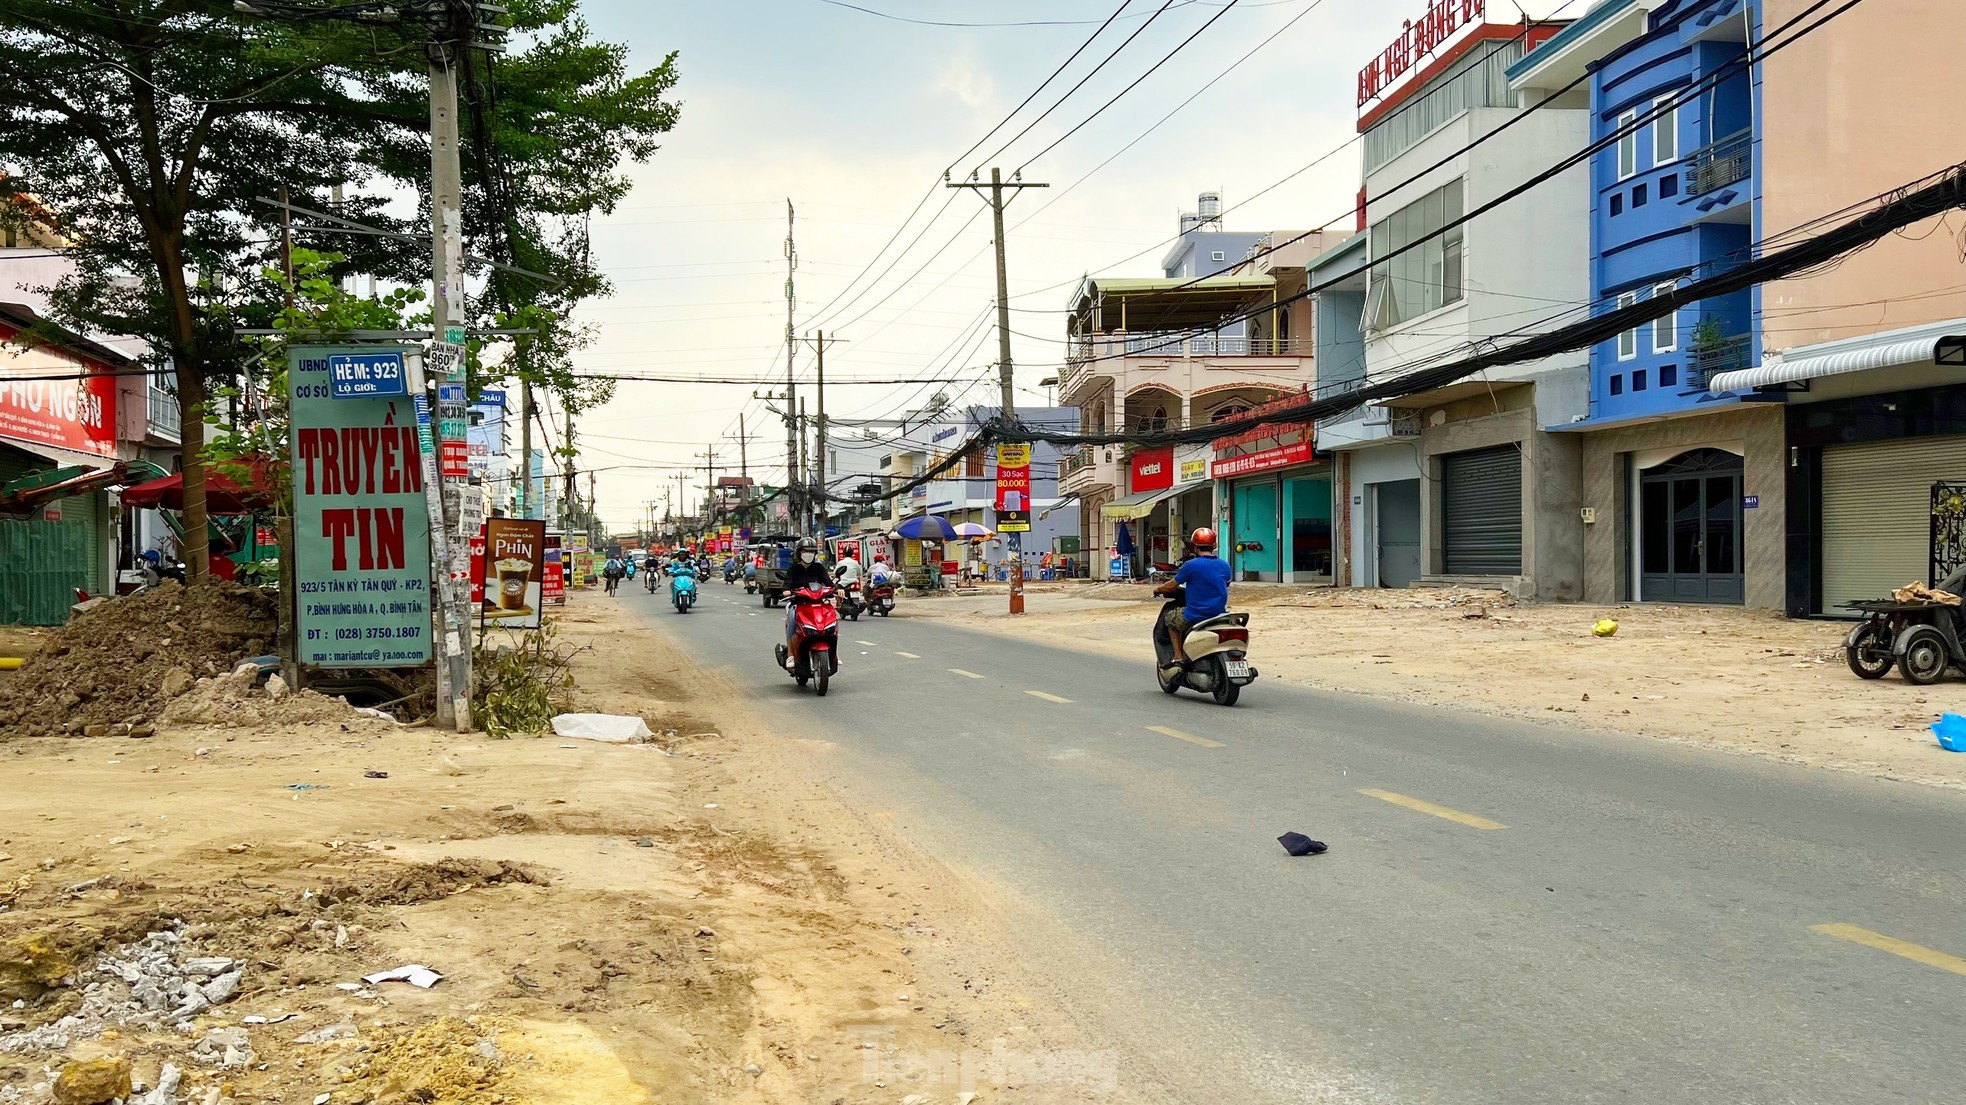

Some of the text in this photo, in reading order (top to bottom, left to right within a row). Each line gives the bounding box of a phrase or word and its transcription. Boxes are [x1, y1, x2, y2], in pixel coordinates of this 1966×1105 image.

[1357, 55, 1380, 108] ANH
[299, 359, 329, 372] UBND
[431, 352, 449, 366] 960
[335, 357, 398, 380] HẺM: 923
[296, 380, 329, 398] CƠ SỞ
[339, 382, 377, 393] LỘ GIỚI:
[298, 402, 422, 496] TRUYỀN
[1012, 471, 1024, 479] Sạc
[1139, 462, 1161, 476] viettel
[322, 508, 405, 571] TIN
[300, 582, 326, 593] 923/5
[328, 579, 345, 592] TÂN
[361, 578, 379, 592] TÂN
[381, 578, 398, 592] QUÝ
[353, 601, 367, 614] HÒA
[408, 600, 422, 613] TÂN
[335, 628, 362, 640] (028)
[366, 627, 421, 639] 3750.1807
